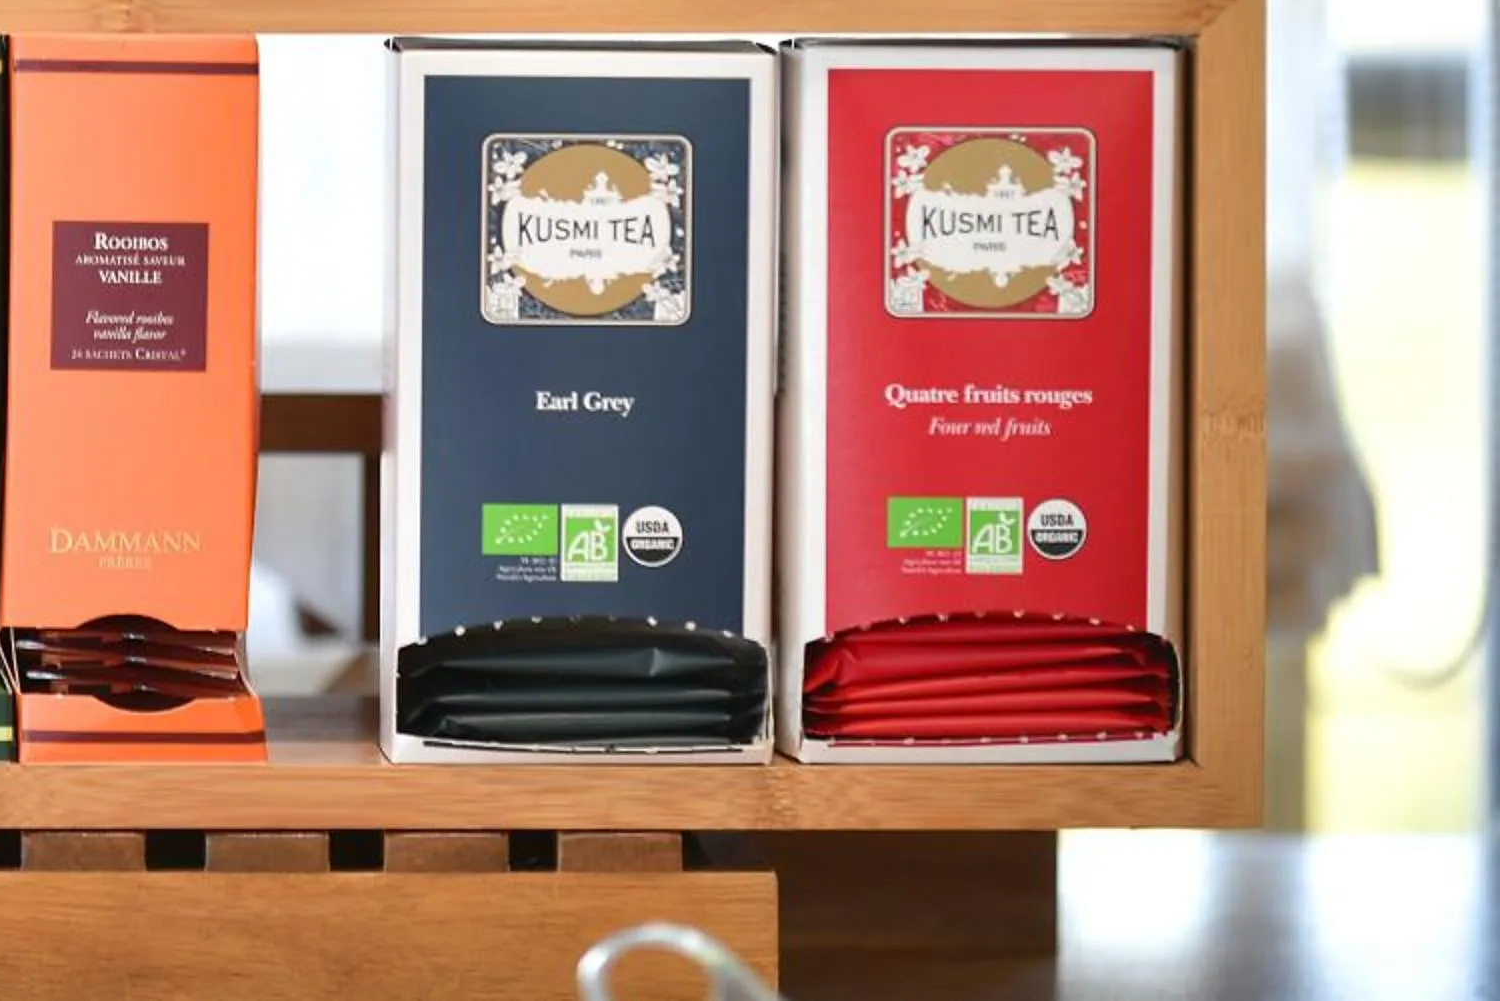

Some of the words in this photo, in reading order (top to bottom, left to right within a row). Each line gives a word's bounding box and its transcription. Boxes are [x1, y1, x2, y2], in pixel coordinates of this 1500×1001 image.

[518, 212, 598, 247] KUSMI
[608, 214, 656, 247] TEA
[921, 205, 1002, 240] KUSMI
[1012, 207, 1059, 241] TEA
[94, 231, 169, 251] ROOIBOS
[75, 253, 140, 266] AROMATISÉ
[143, 255, 186, 266] SAVEUR
[98, 270, 162, 284] VANILLE
[85, 310, 135, 324] Flavored
[535, 390, 578, 411] Earl
[583, 390, 635, 418] Grey
[884, 383, 959, 409] Quatre
[963, 383, 1020, 404] fruits
[1024, 387, 1092, 410] rouges
[928, 417, 972, 436] Four
[974, 417, 1000, 435] red
[1002, 417, 1052, 441] fruits
[636, 521, 669, 534] USDA
[1040, 514, 1074, 527] USDA
[50, 527, 201, 554] DAMMANN
[568, 529, 608, 561] AB
[972, 523, 1013, 553] AB
